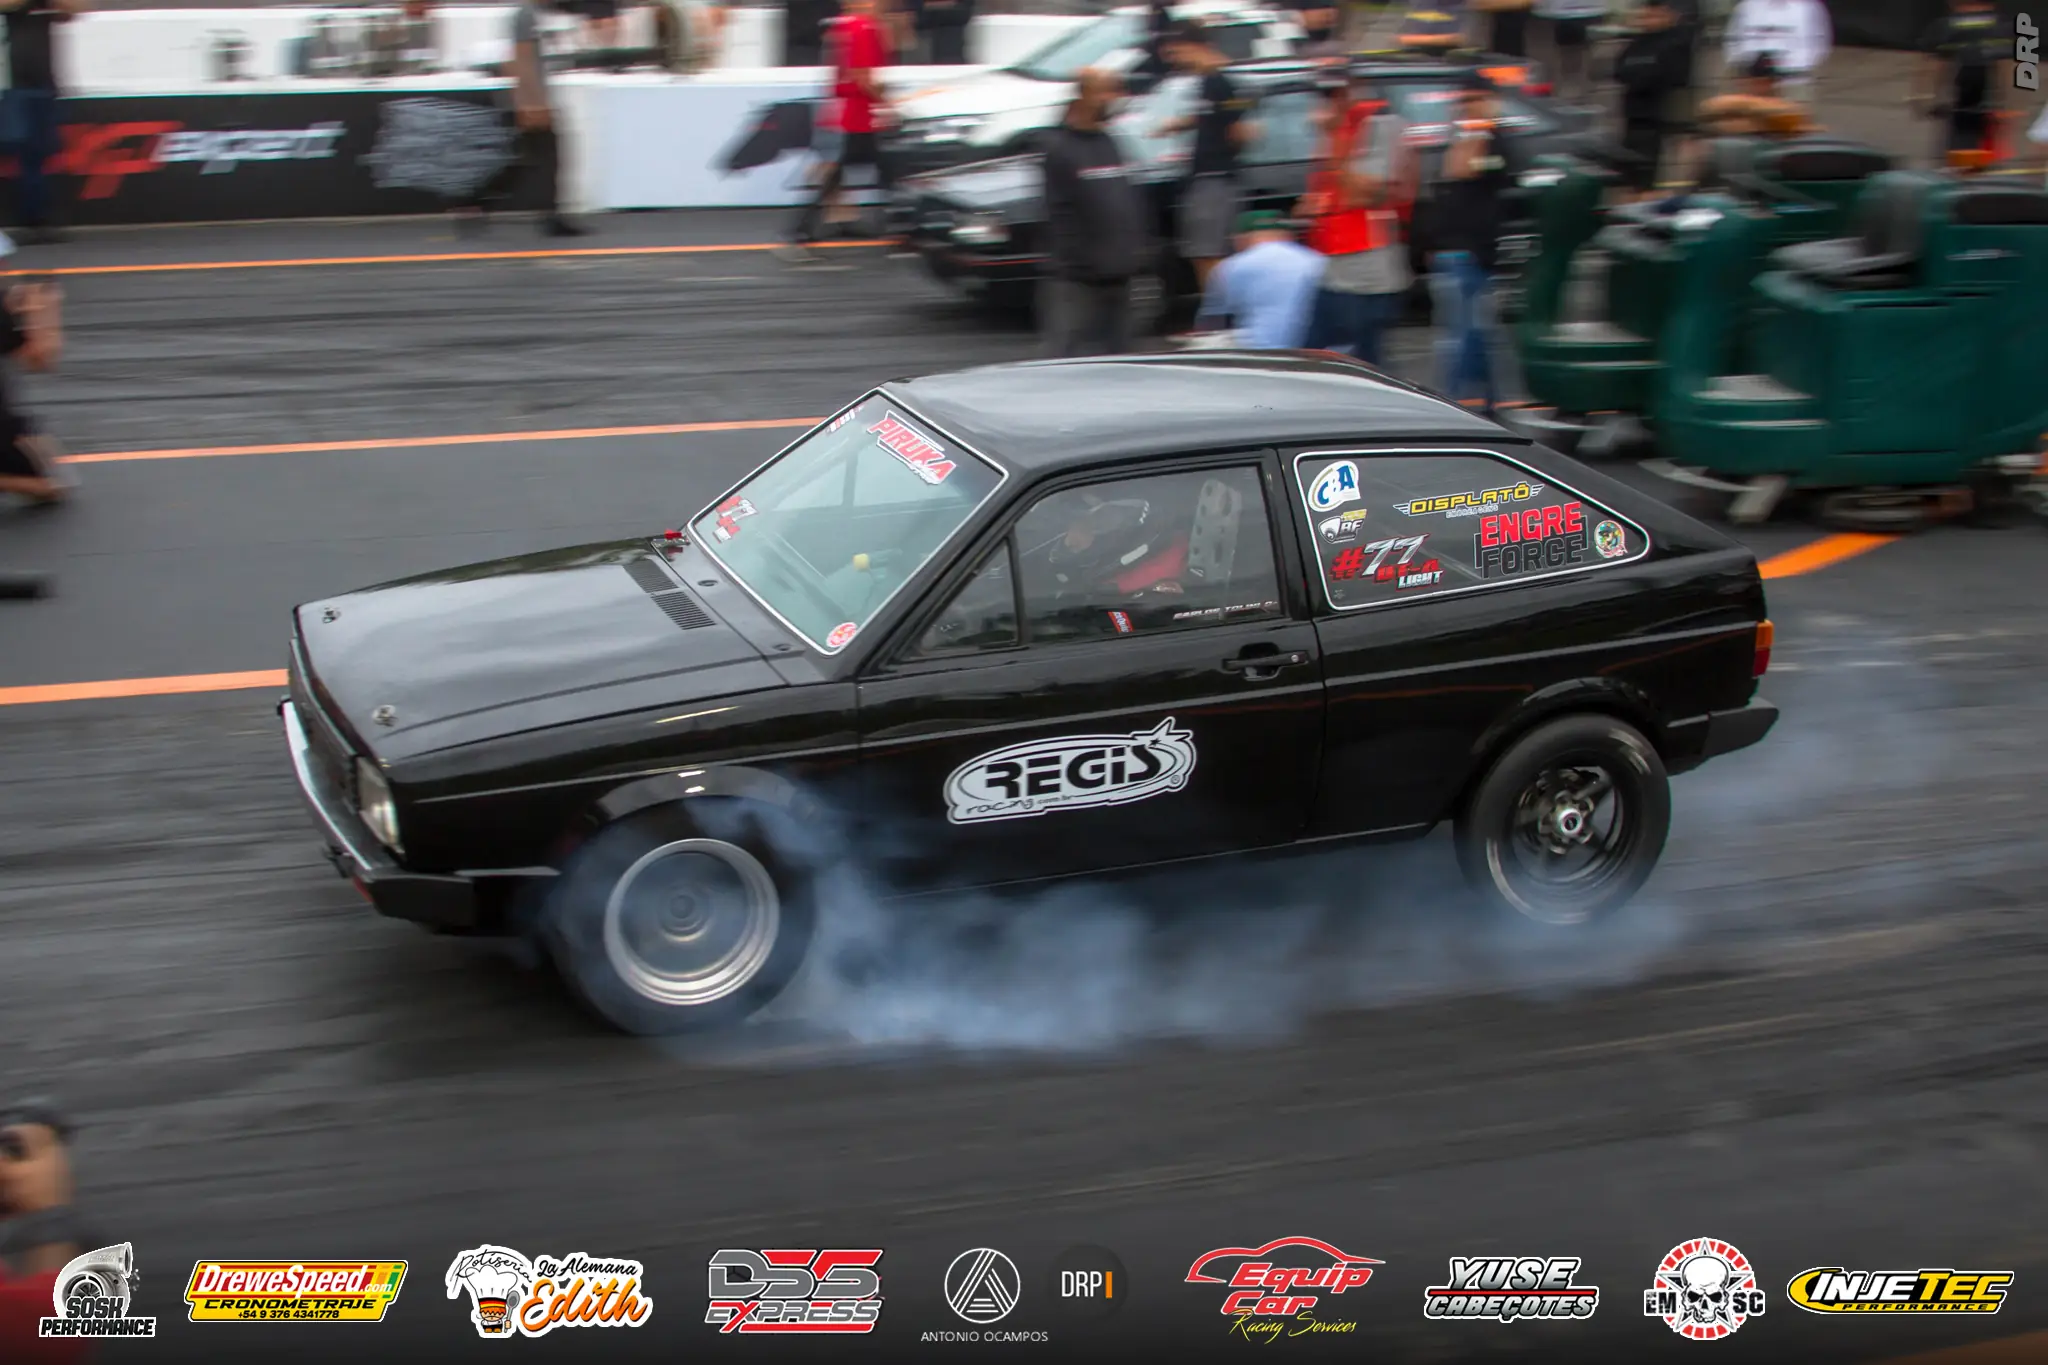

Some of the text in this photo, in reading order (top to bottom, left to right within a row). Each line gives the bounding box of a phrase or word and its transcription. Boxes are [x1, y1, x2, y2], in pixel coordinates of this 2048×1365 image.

[867, 416, 957, 481] PIRUKA
[1317, 464, 1355, 506] CBA
[1410, 483, 1531, 515] DISPLATÔ
[1480, 502, 1583, 548] ENGRE
[1331, 533, 1430, 577] #77
[1481, 533, 1584, 580] FORGE
[1398, 570, 1443, 589] LIGHT
